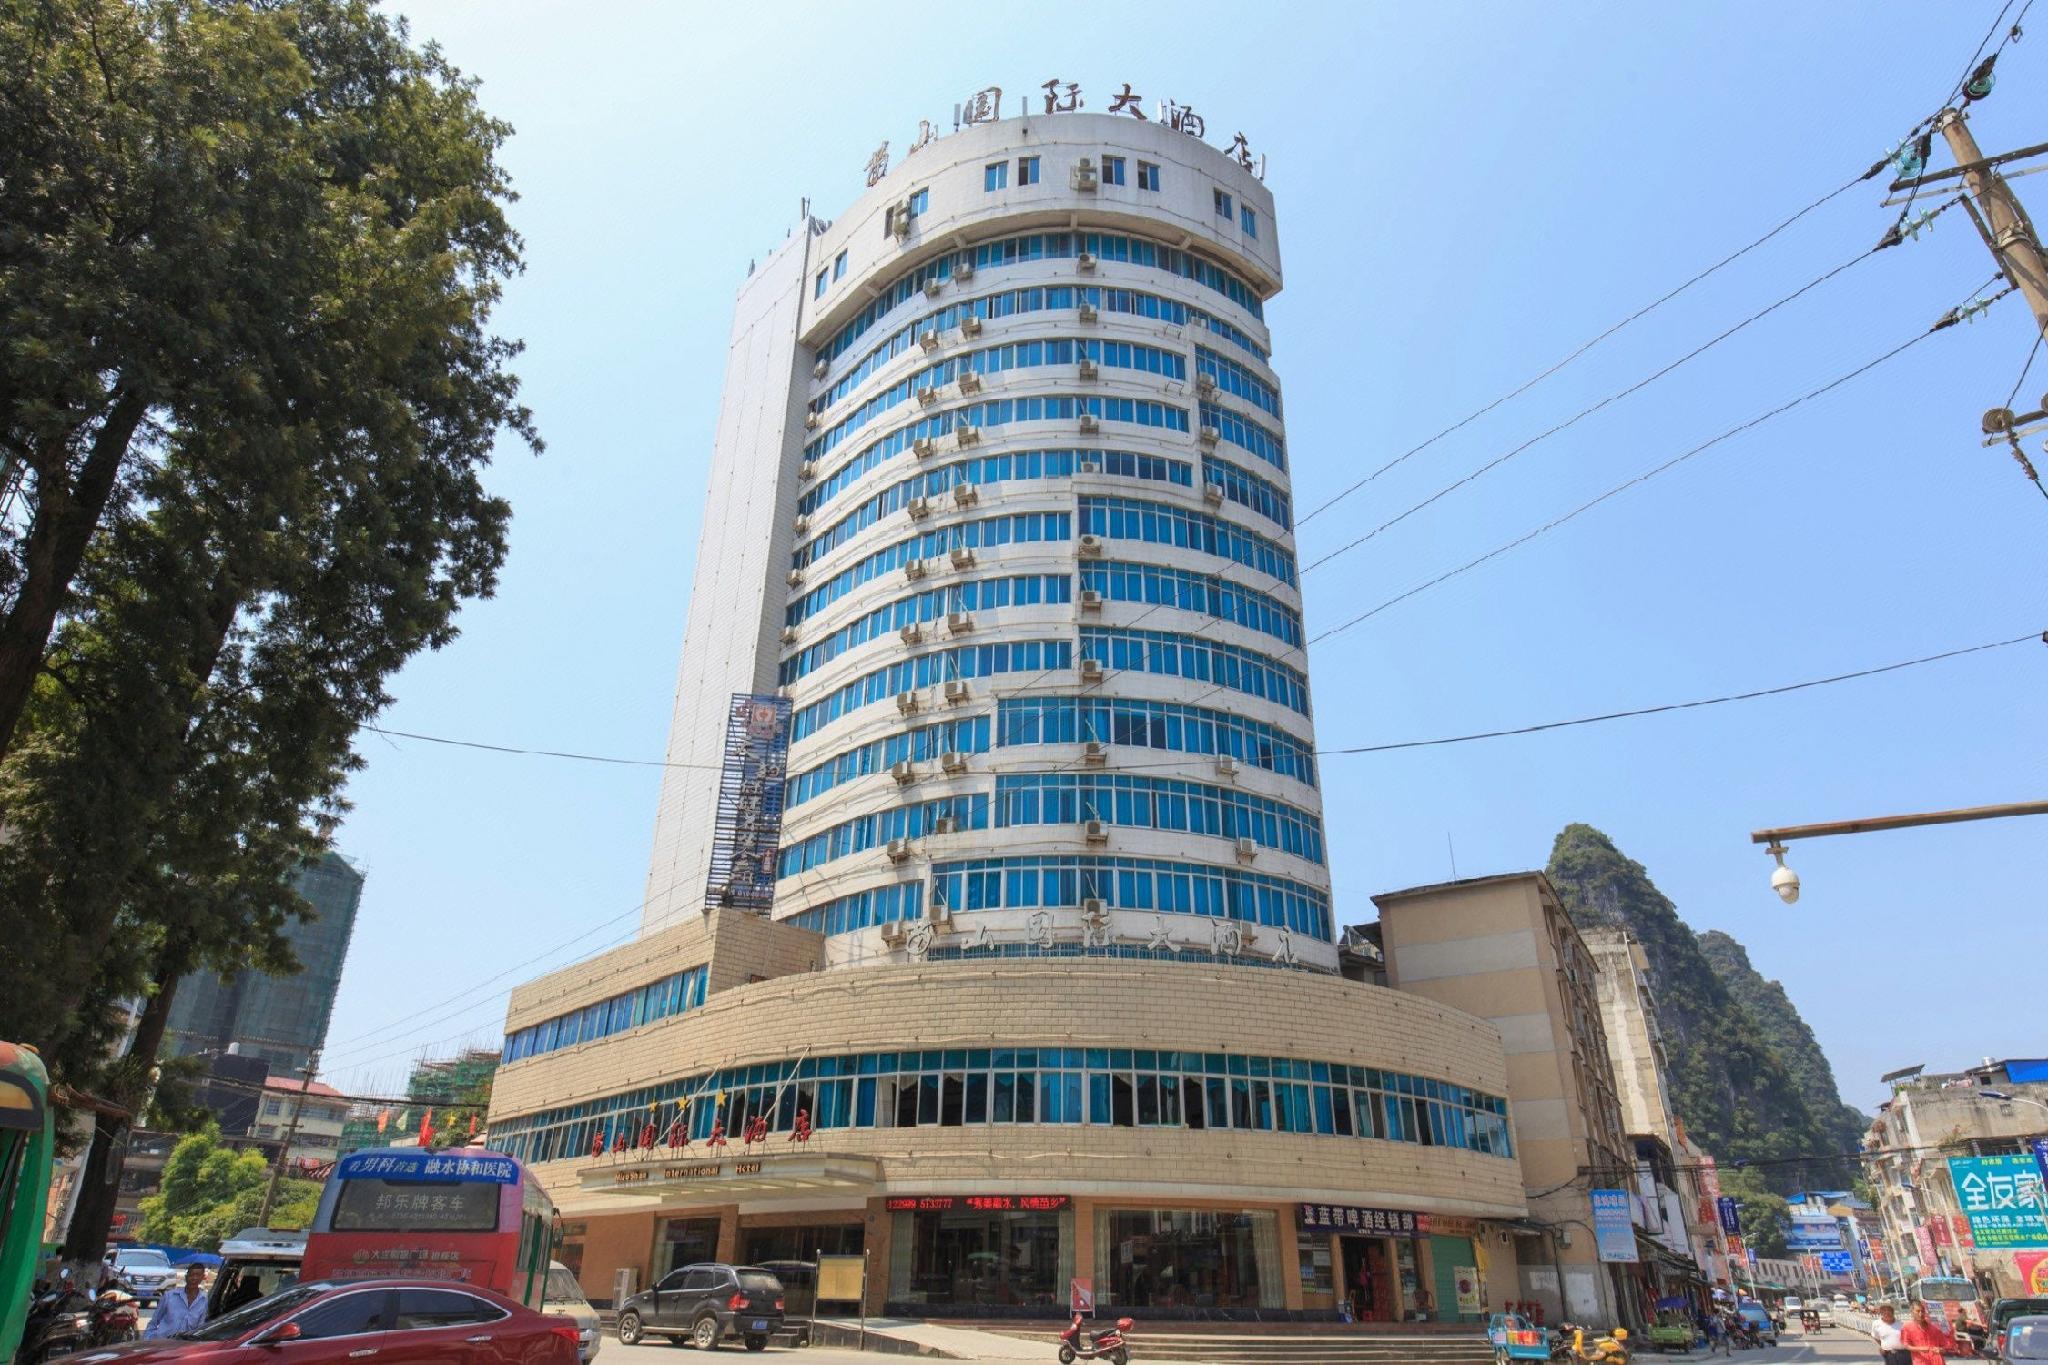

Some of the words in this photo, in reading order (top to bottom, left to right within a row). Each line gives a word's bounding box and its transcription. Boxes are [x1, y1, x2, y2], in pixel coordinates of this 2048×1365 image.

[424, 1158, 513, 1178] 融水协和医院
[663, 1166, 720, 1179] International
[736, 1163, 760, 1174] Hotel
[375, 1193, 465, 1211] 邦乐牌客车
